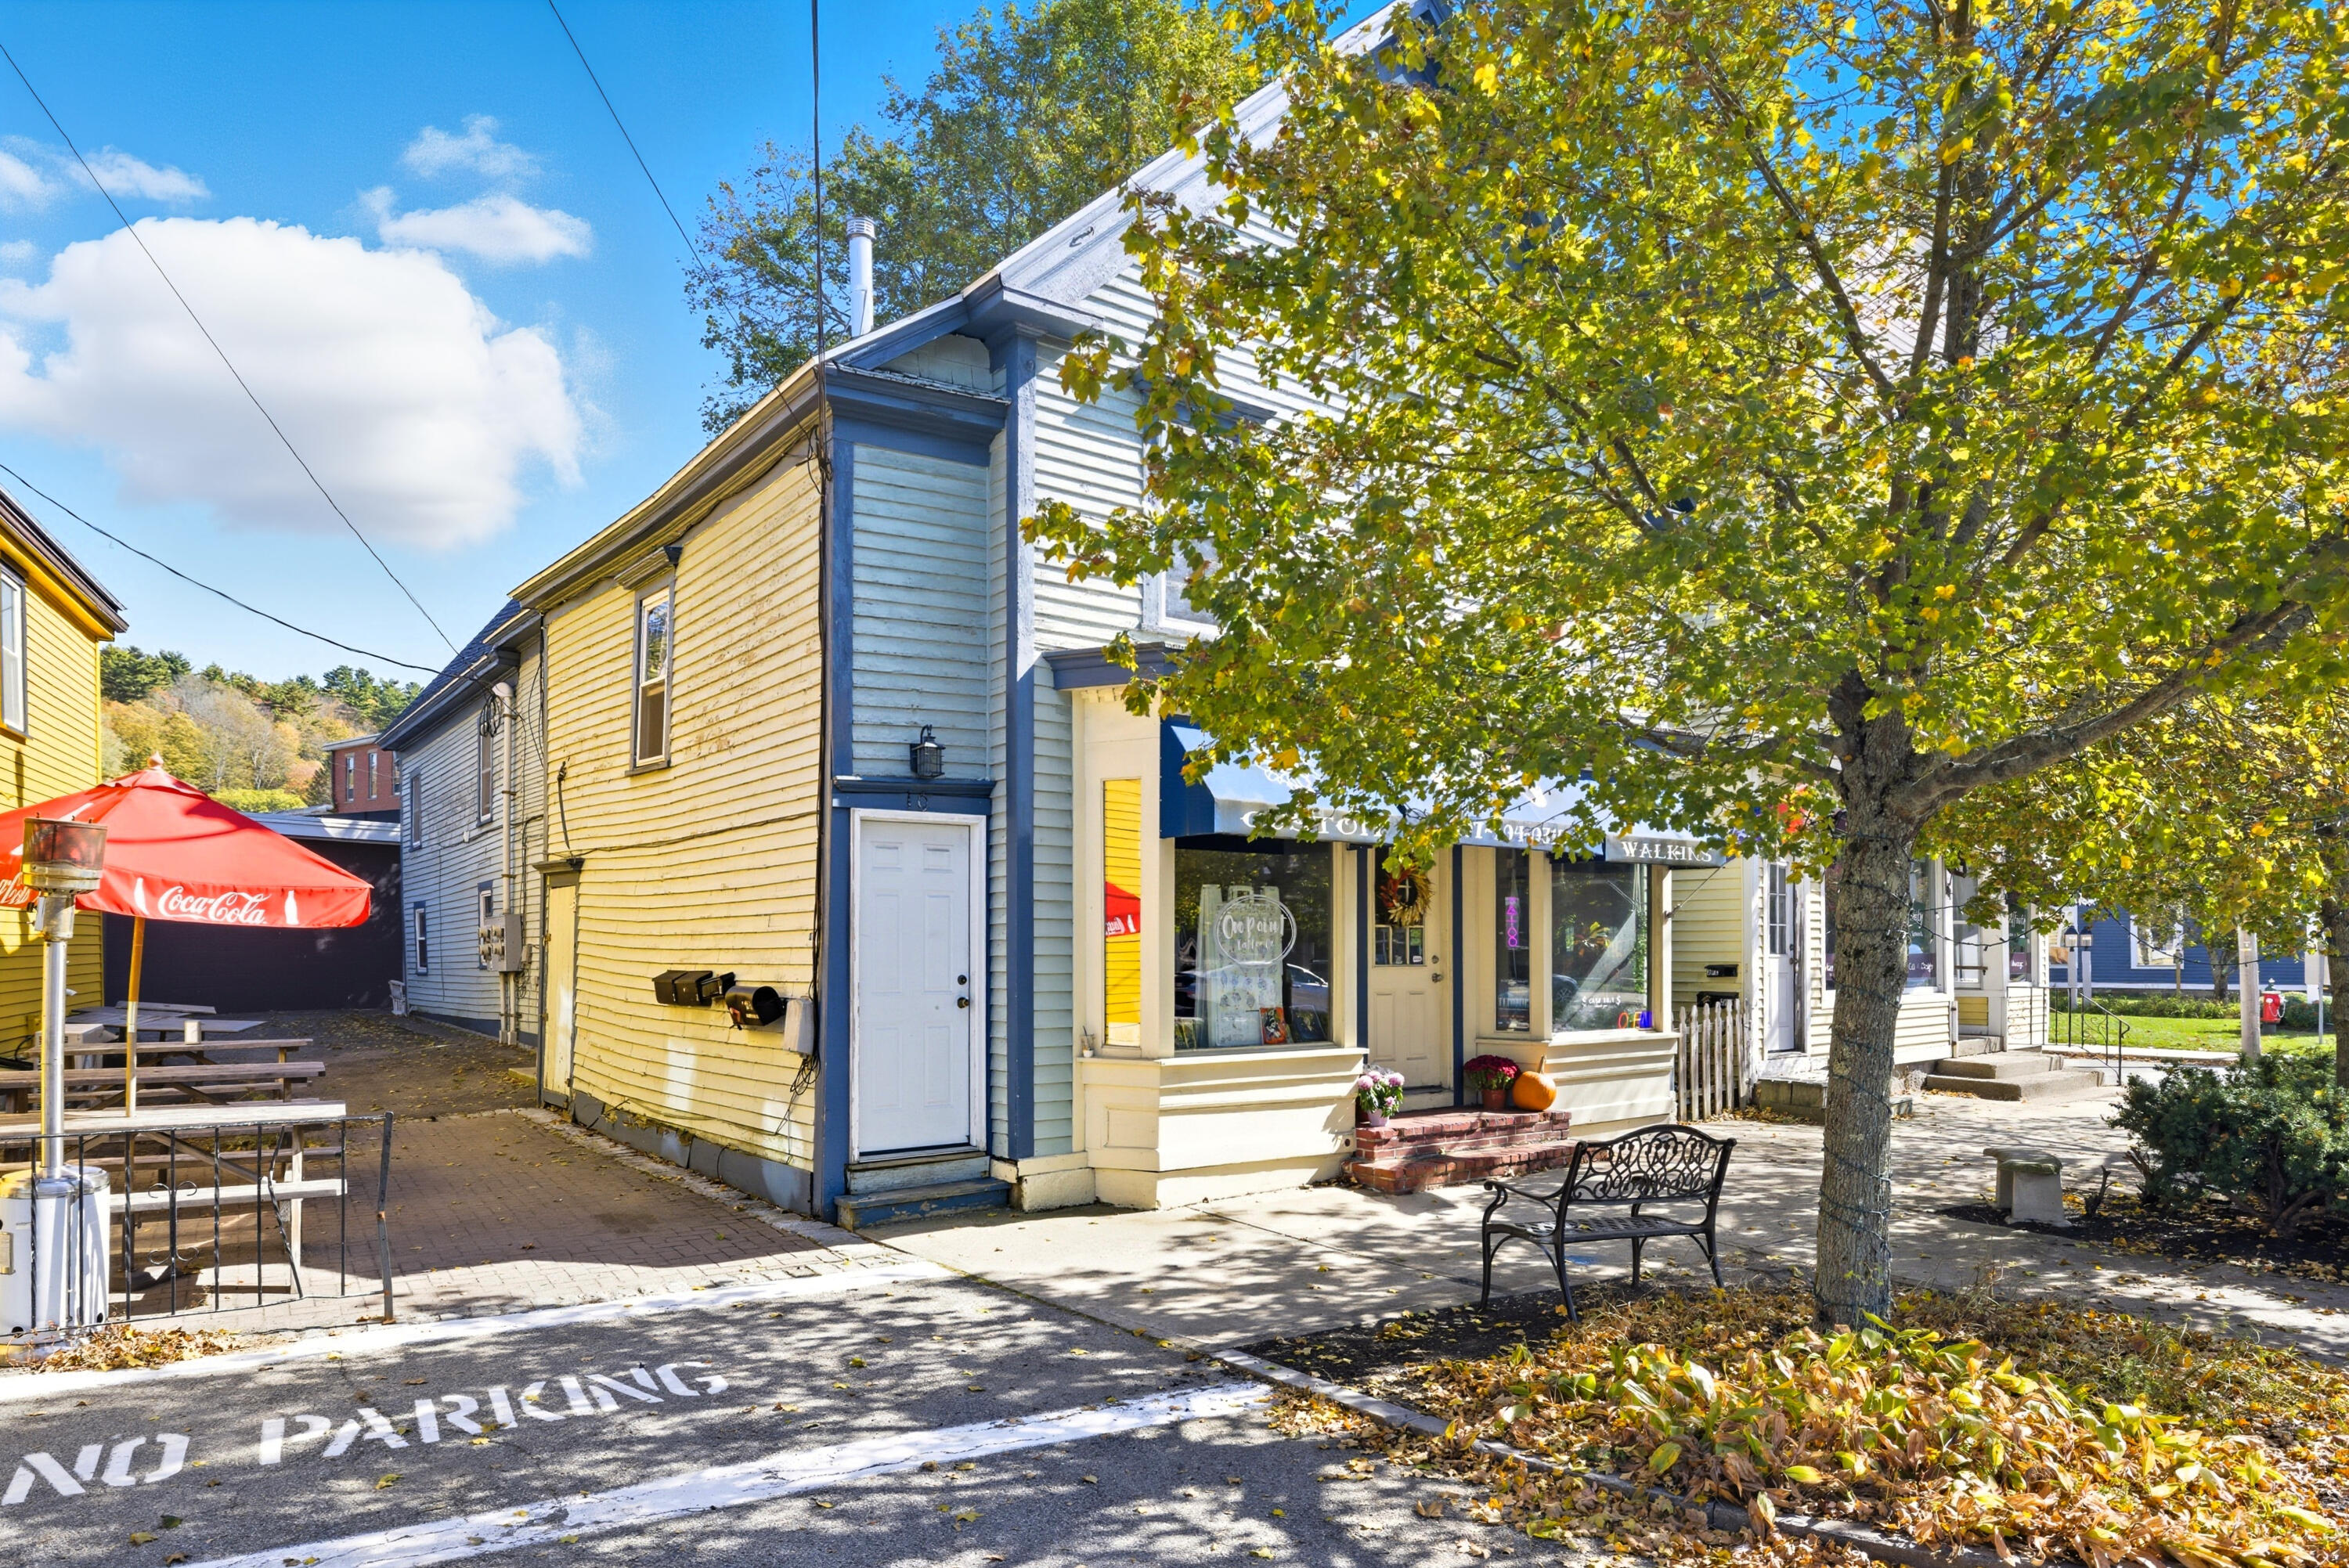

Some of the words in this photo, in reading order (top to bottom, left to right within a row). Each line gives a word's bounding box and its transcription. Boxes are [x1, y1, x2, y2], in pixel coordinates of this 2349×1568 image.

[157, 885, 272, 924] Coca-Cola
[2, 1433, 190, 1506] NO
[259, 1361, 729, 1465] PARKING
